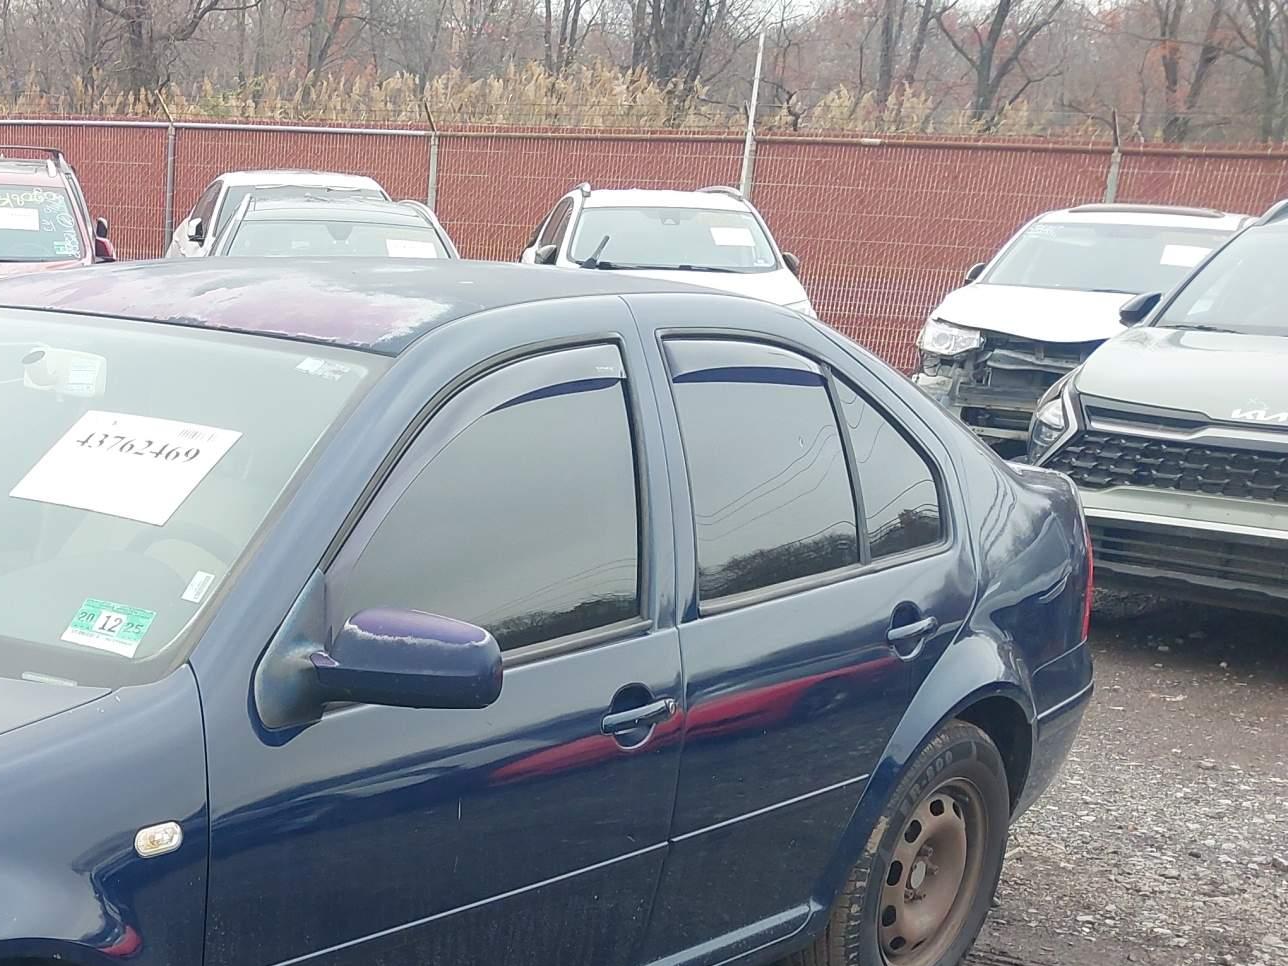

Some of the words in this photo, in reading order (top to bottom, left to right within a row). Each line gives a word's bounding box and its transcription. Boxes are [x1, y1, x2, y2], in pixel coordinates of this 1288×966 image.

[75, 431, 201, 464] 43762469
[78, 611, 96, 623] 20
[98, 615, 123, 633] 12
[123, 622, 145, 635] 25
